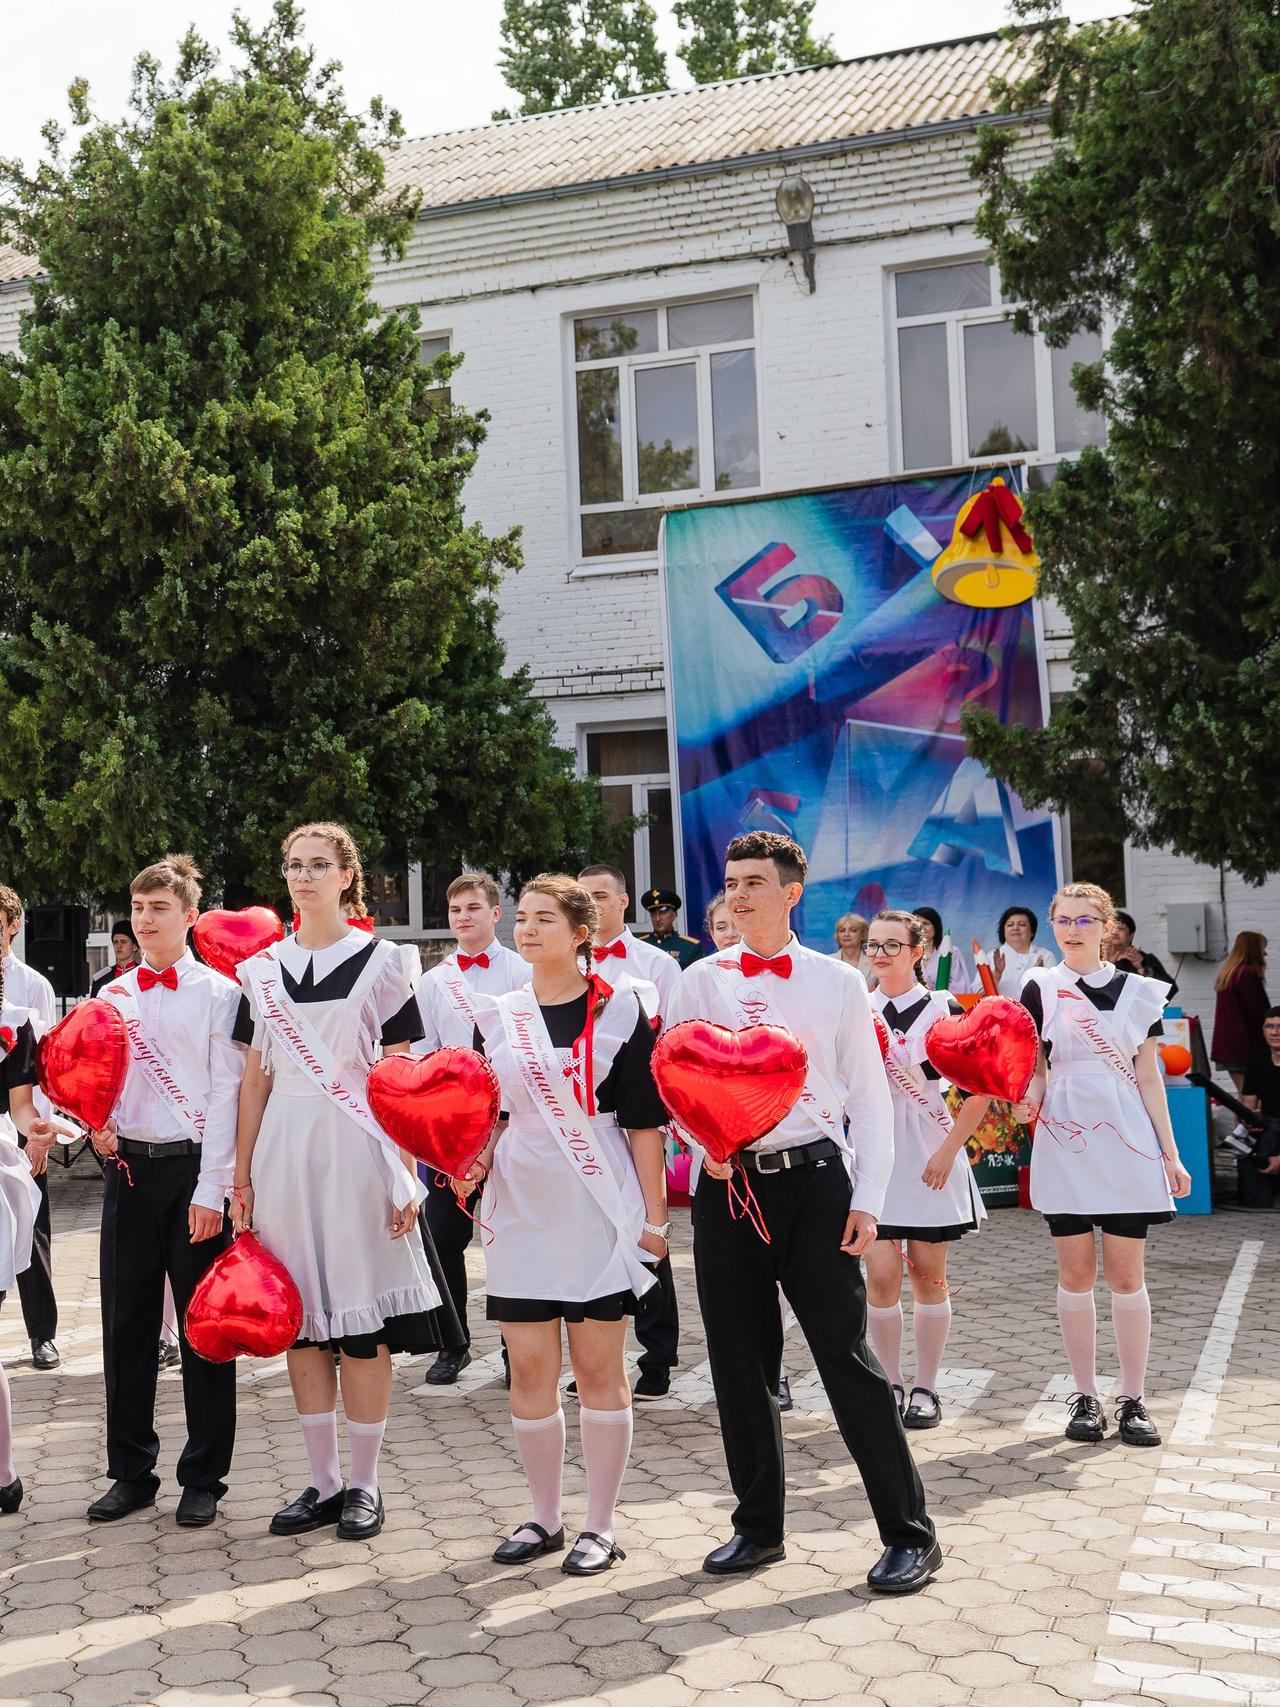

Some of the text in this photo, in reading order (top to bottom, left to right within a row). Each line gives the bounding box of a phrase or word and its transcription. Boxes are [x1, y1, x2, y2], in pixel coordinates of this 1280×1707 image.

[124, 1010, 188, 1106] Выпускник
[260, 967, 324, 1077] Выпускница
[510, 999, 604, 1175] Выпускница 2026
